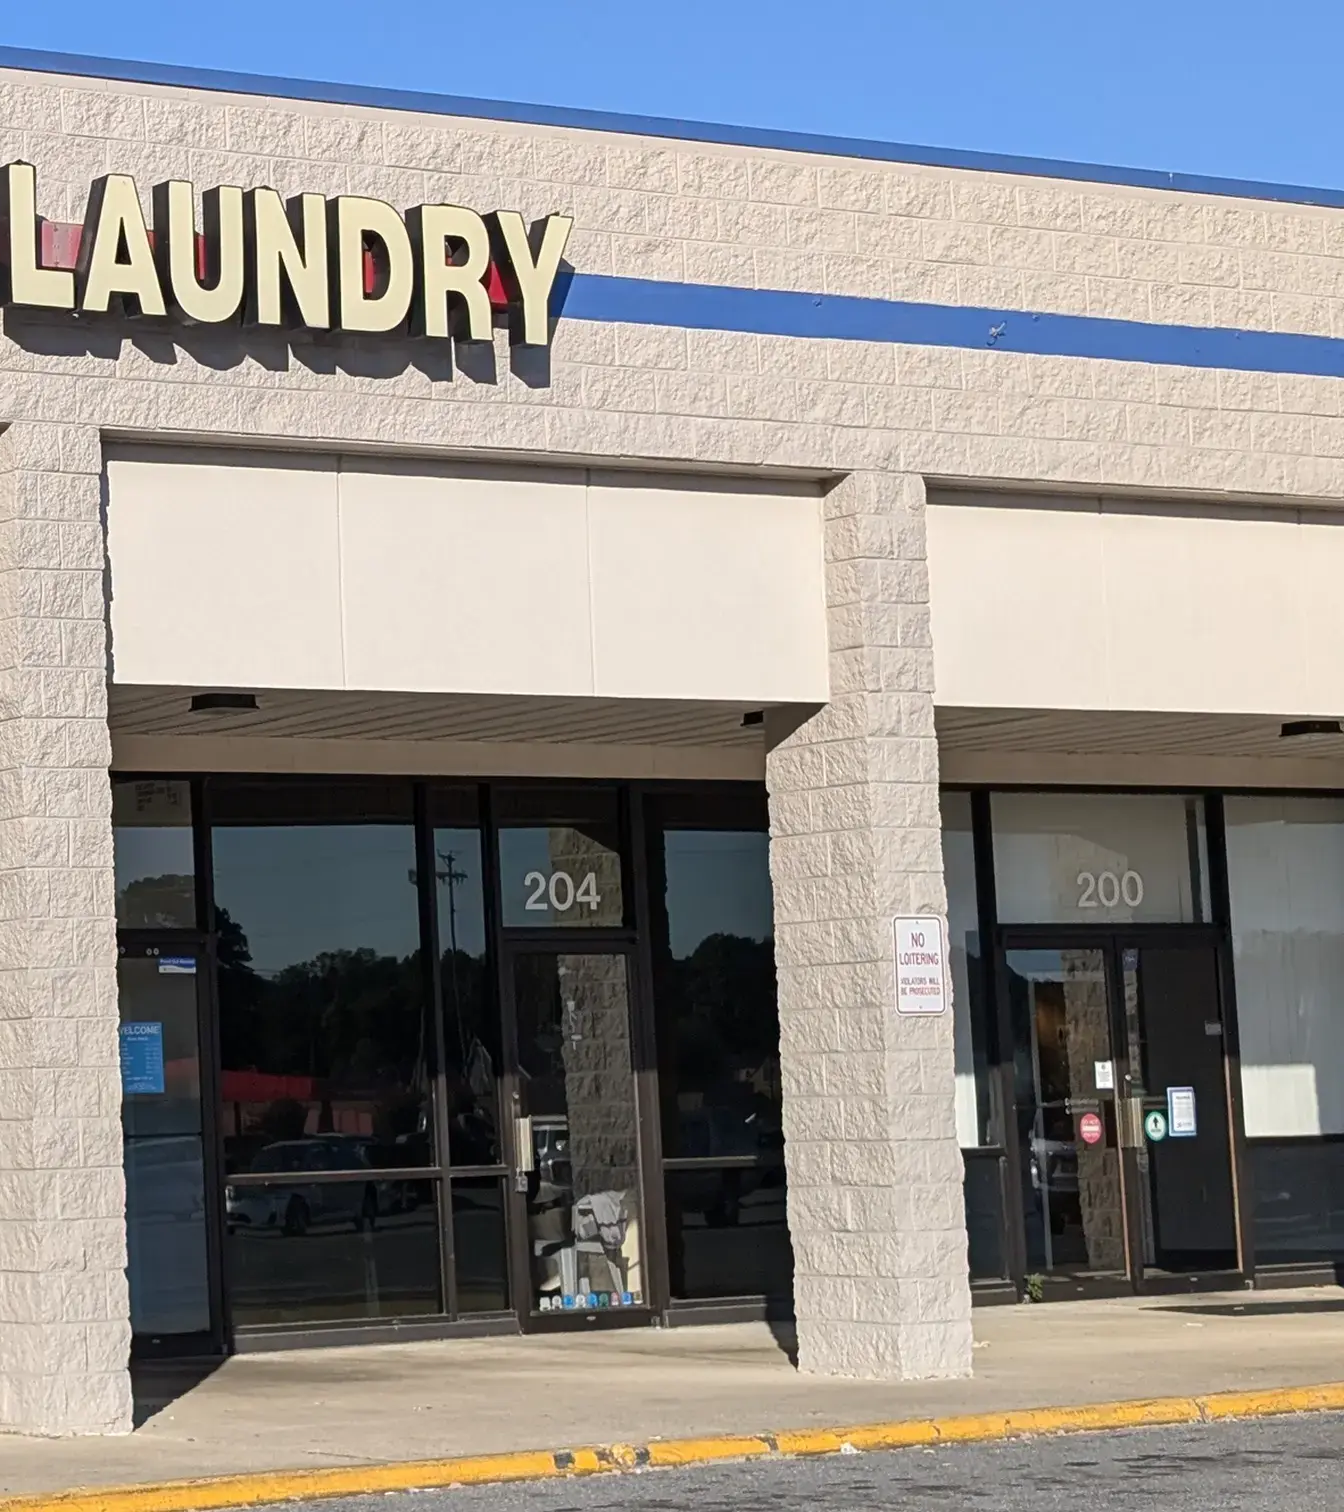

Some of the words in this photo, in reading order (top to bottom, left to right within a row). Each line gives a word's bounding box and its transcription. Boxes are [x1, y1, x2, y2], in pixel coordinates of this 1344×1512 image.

[523, 870, 602, 912] 204
[1076, 870, 1145, 908] 200
[910, 931, 926, 948] NO
[898, 952, 940, 967] LOITERING
[900, 976, 927, 986] VIOLATORS
[928, 976, 941, 986] WILL
[900, 986, 908, 996] BE
[909, 986, 941, 997] PROSECUTED
